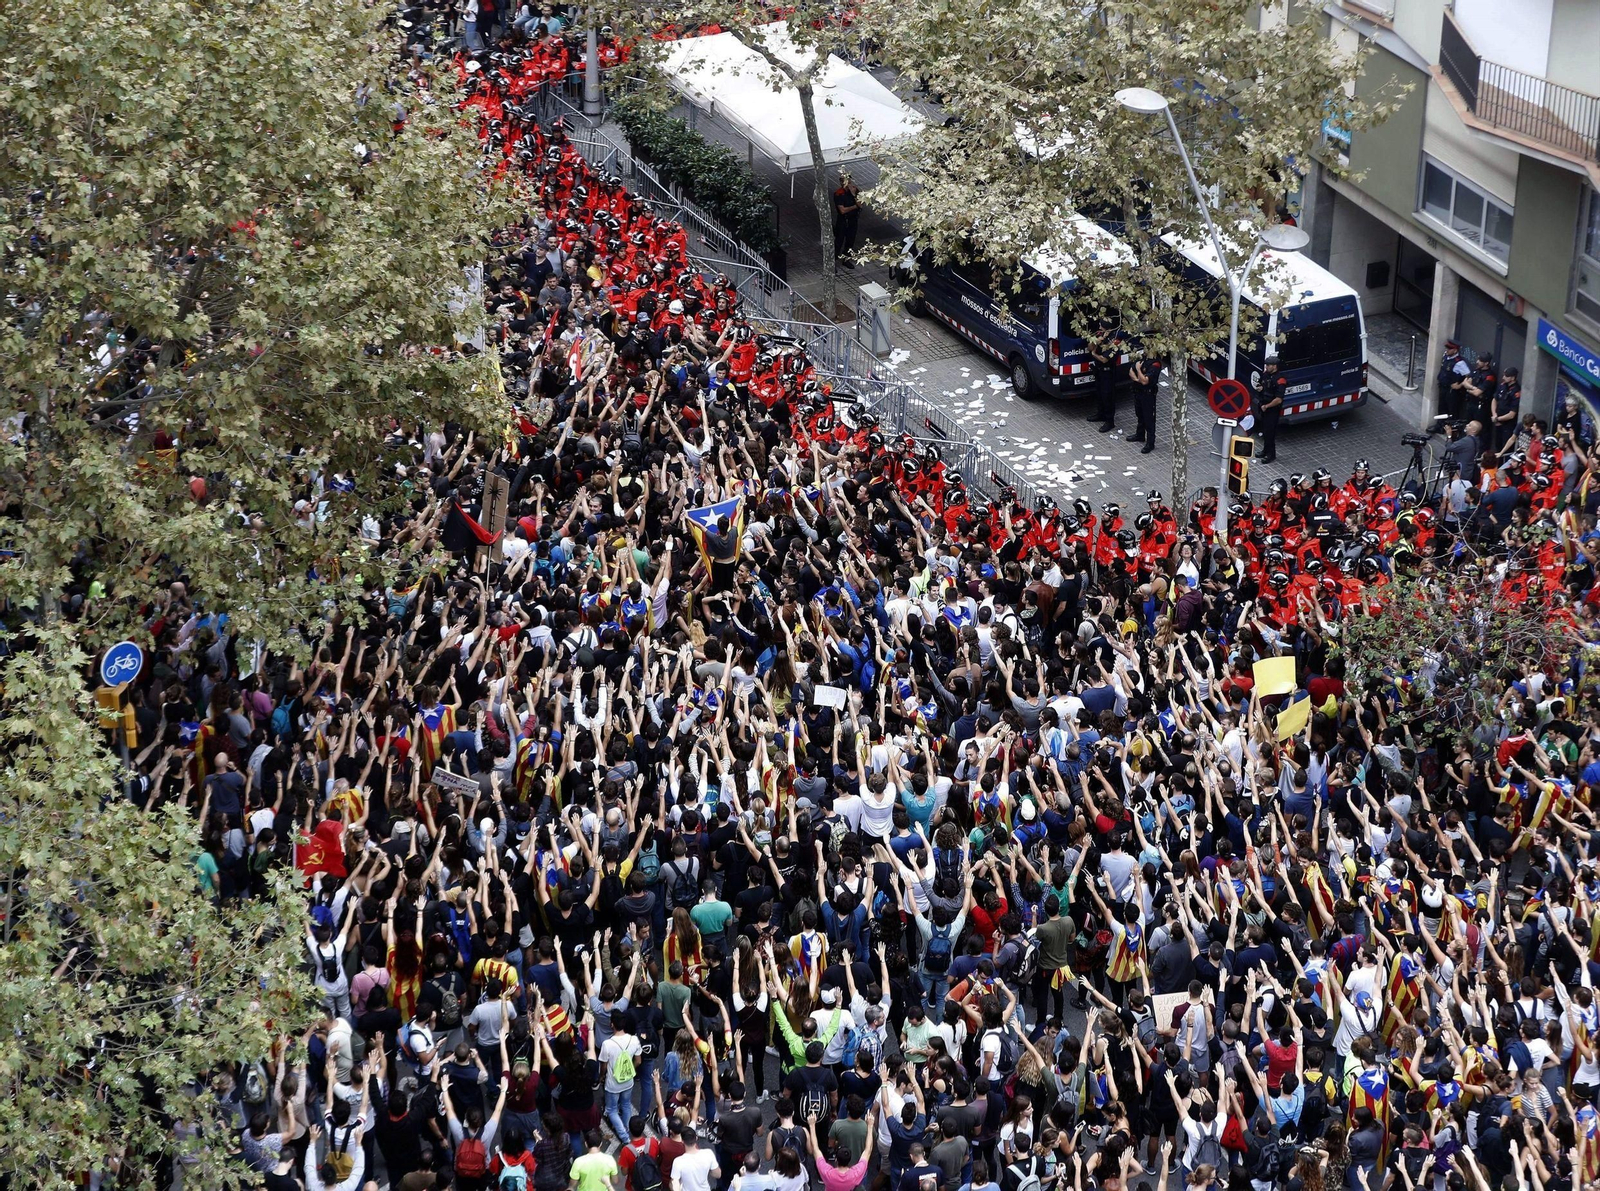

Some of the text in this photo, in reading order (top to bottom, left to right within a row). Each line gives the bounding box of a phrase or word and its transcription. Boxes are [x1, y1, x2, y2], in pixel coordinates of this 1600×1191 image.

[961, 294, 984, 315] mossos
[1063, 348, 1084, 358] policia
[1558, 339, 1585, 367] Banco
[1586, 358, 1600, 380] Ca
